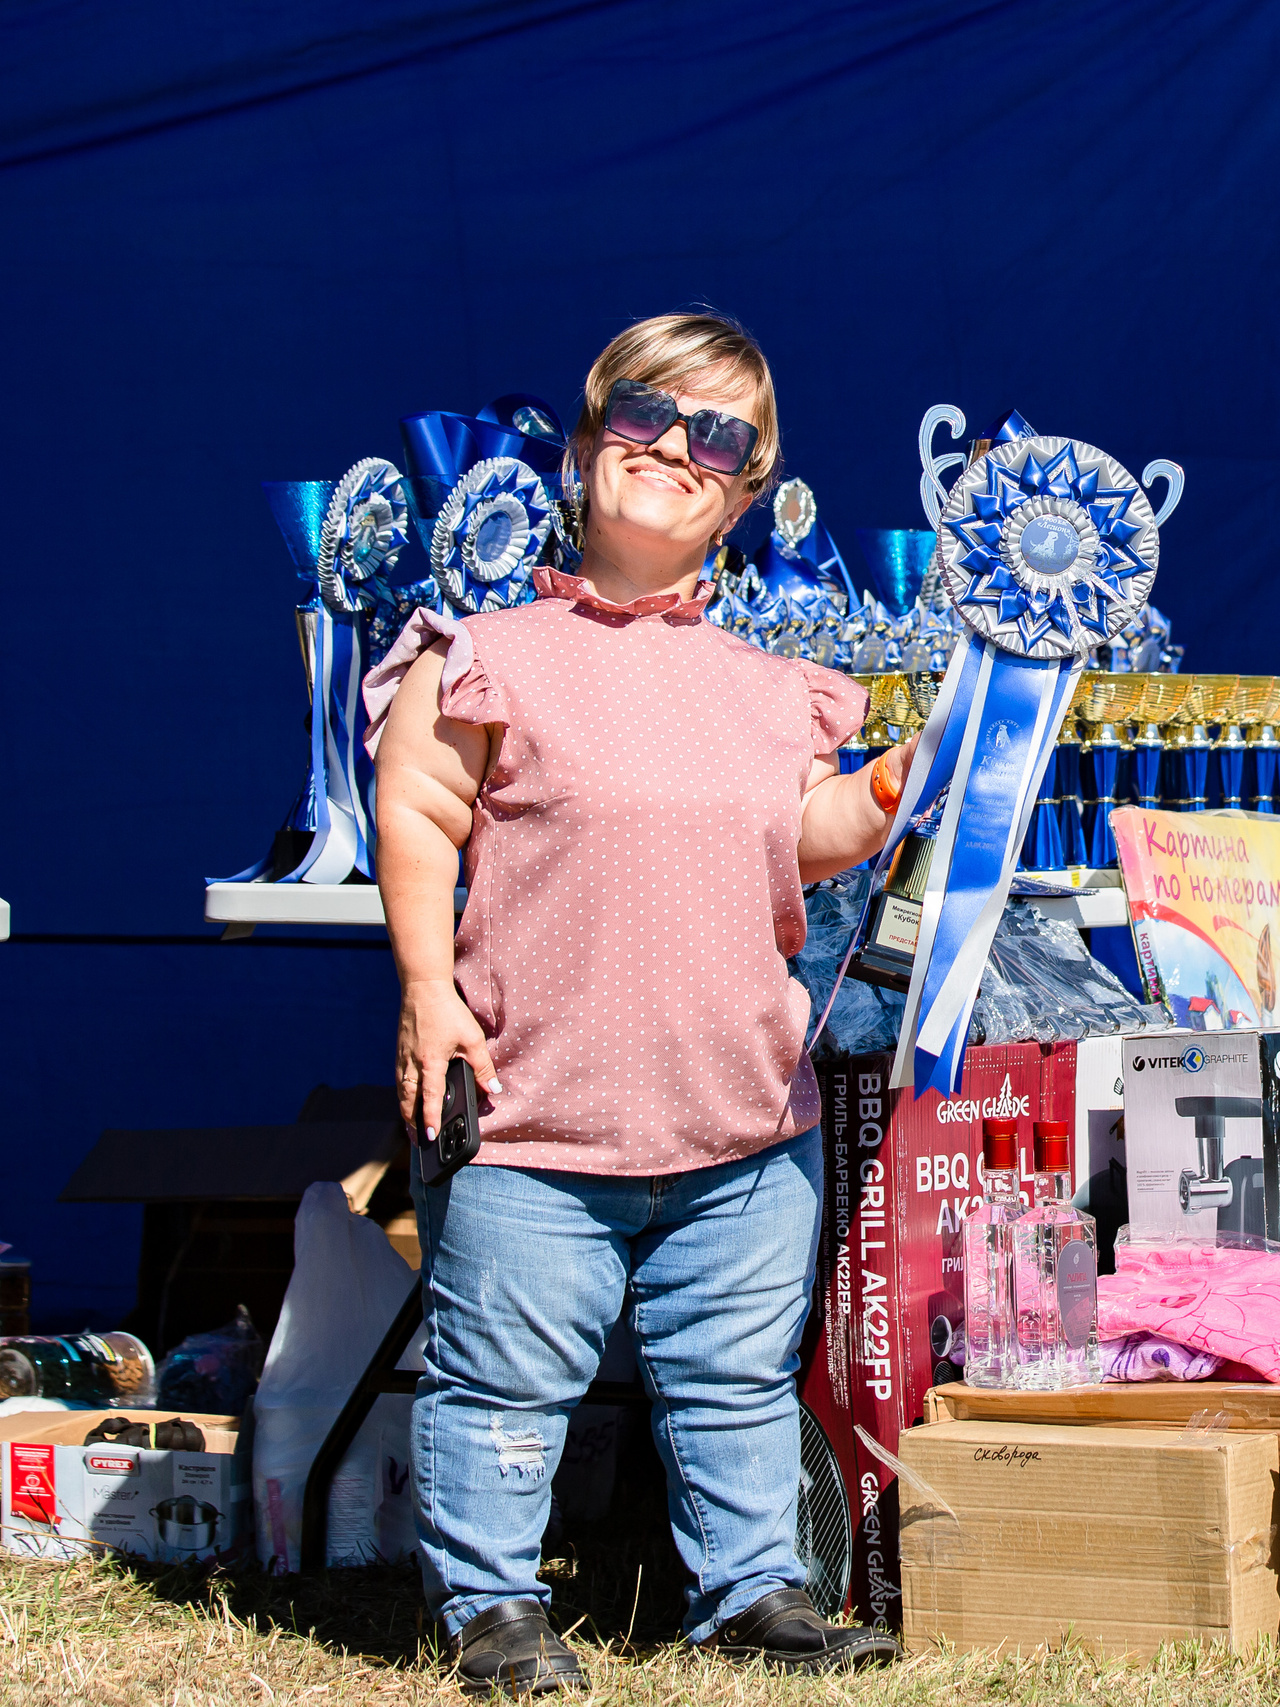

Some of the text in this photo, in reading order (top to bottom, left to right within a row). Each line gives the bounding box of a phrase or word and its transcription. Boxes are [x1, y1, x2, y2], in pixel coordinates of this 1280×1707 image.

[1143, 818, 1250, 874] Картина
[1153, 874, 1181, 901] по
[1148, 1057, 1187, 1070] VITEK
[1203, 1053, 1249, 1065] GRAPHITE
[937, 1083, 1031, 1124] GREEN GLADE
[833, 1073, 850, 1238] ГРИЛЬ-БАРБЕКЮ
[916, 1152, 971, 1193] BBQ
[858, 1073, 893, 1401] BBQ GRILL AK22FP
[93, 1458, 131, 1469] PYREX
